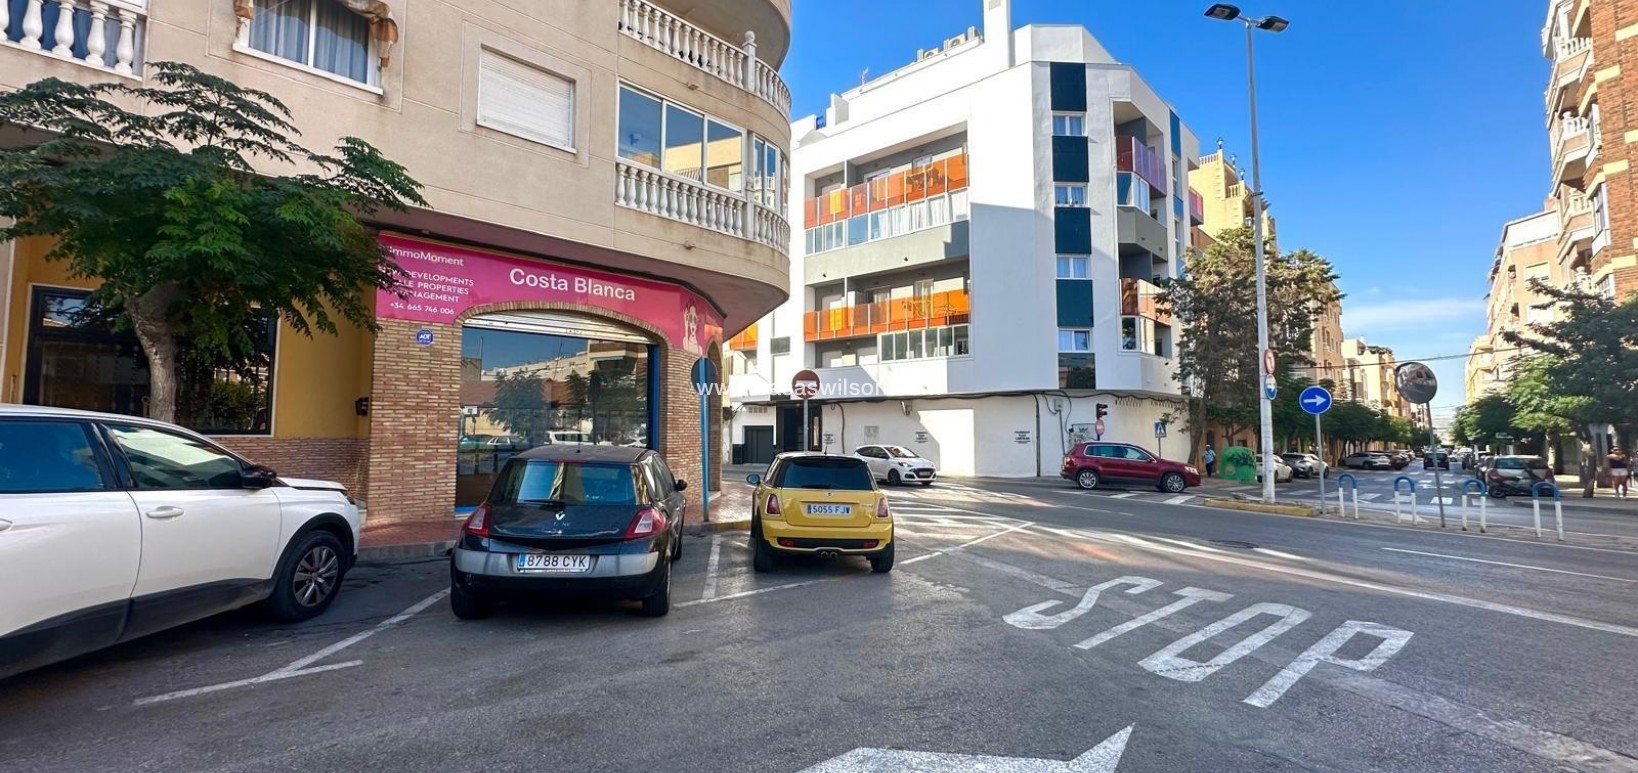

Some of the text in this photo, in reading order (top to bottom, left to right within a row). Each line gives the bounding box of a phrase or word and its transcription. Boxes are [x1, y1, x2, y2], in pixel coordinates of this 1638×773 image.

[417, 281, 470, 295] PROPERTIES
[509, 268, 636, 301] Costa Blanca
[395, 287, 459, 303] NAGEMENT
[424, 305, 438, 313] 746
[440, 307, 455, 315] 006
[812, 505, 833, 514] 5055
[527, 555, 586, 568] 8788 CYK
[1002, 575, 1414, 708] STOP
